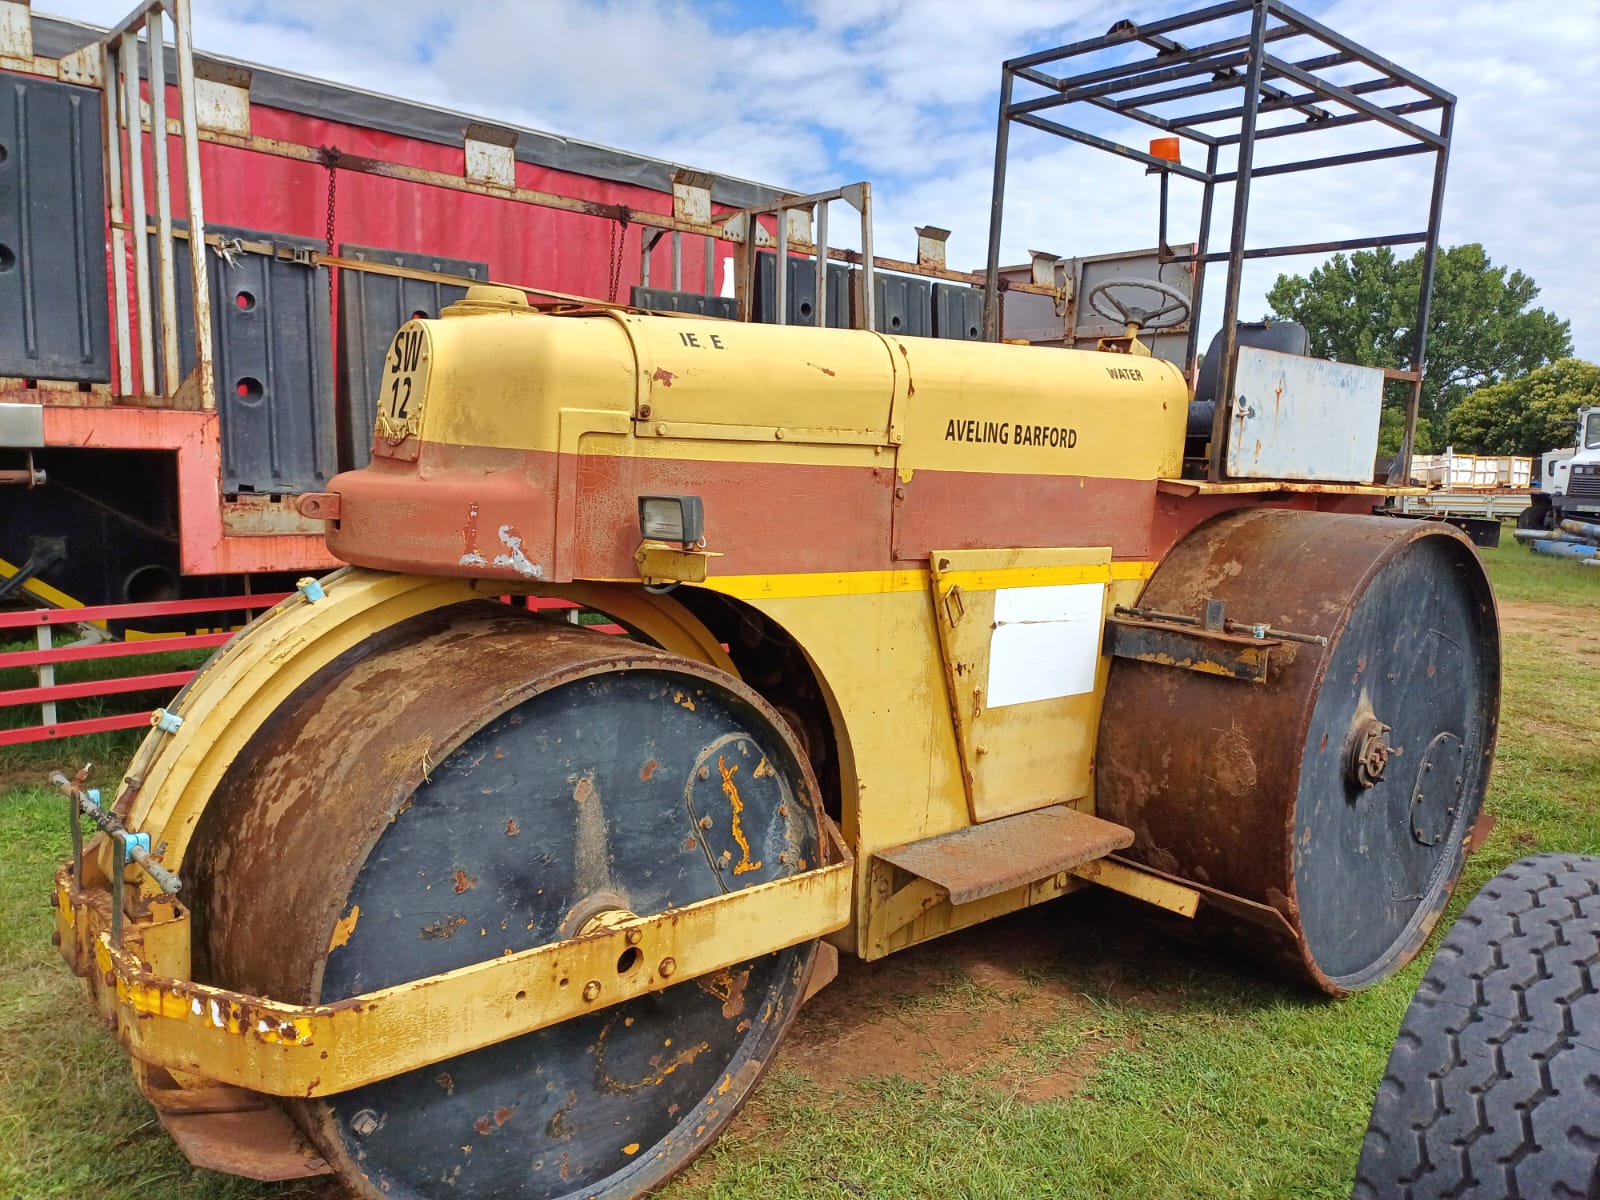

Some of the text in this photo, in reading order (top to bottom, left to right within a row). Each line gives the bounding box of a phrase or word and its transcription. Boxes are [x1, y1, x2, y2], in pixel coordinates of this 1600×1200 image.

[391, 330, 424, 374] SW
[1105, 367, 1144, 382] WATER
[390, 376, 412, 419] 12
[944, 418, 1077, 449] AVELING BARFORD
